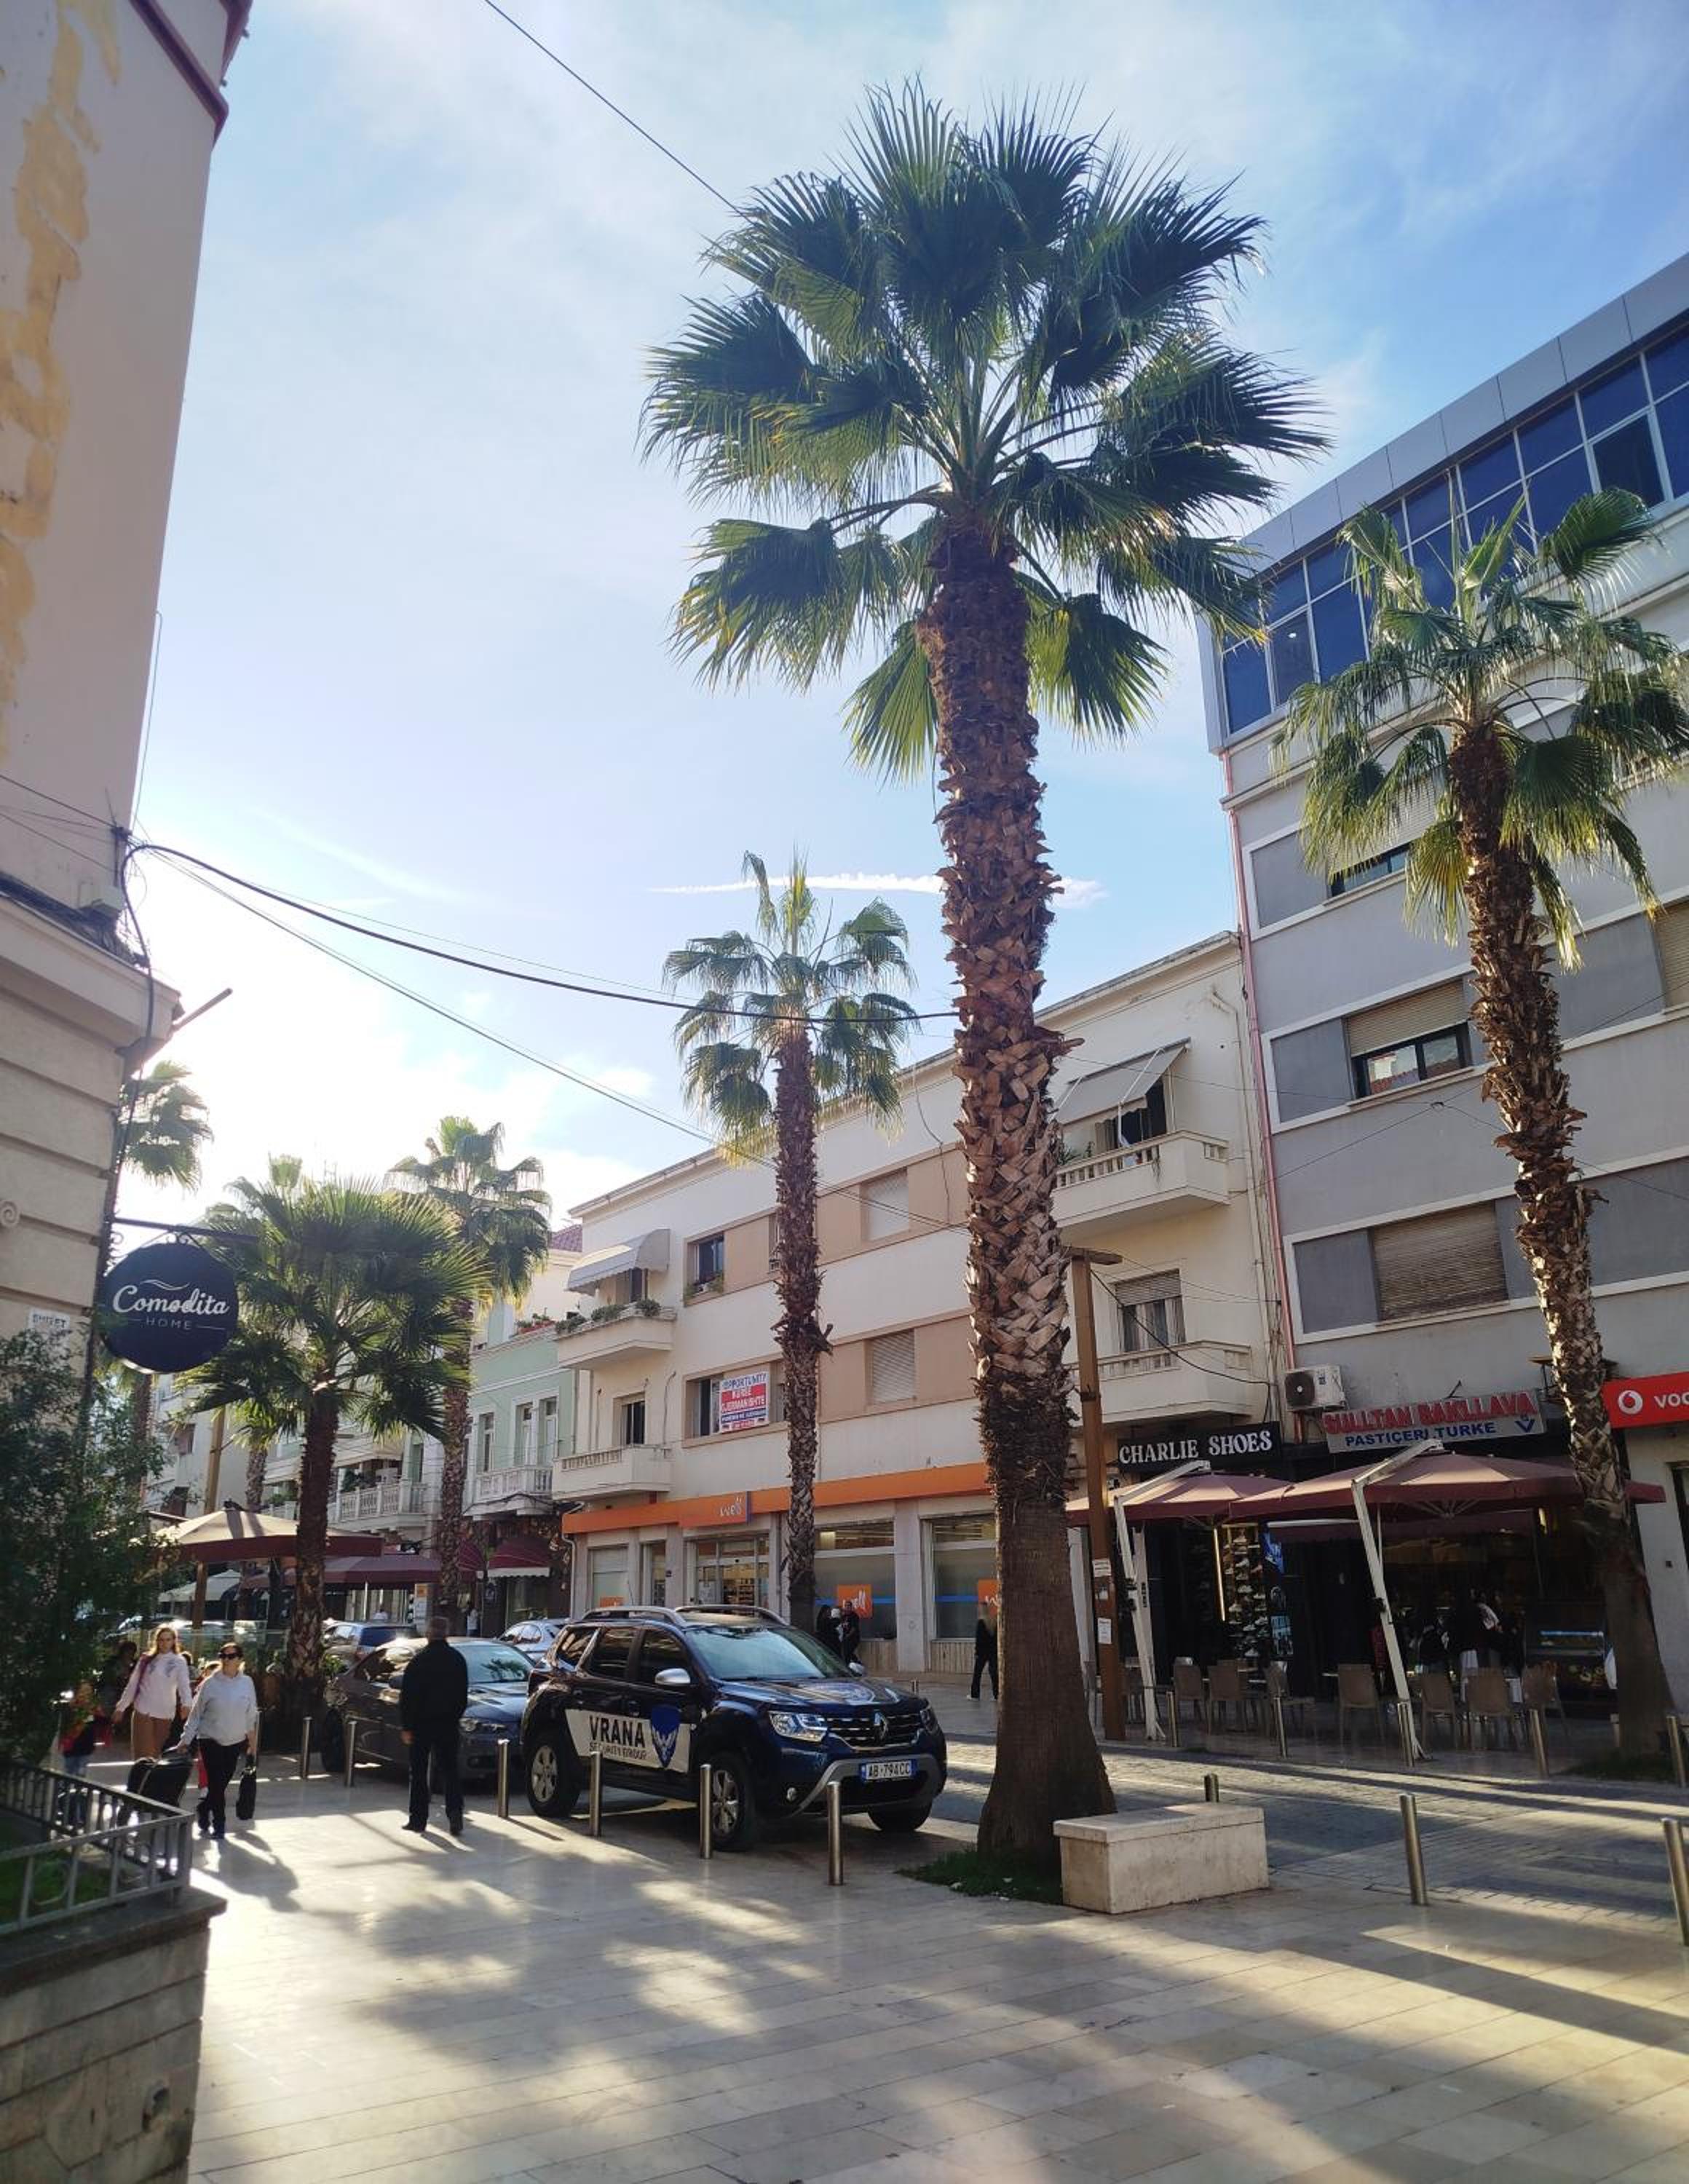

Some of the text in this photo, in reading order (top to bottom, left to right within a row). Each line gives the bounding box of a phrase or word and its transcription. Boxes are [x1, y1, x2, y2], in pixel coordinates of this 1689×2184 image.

[113, 1285, 231, 1315] Comodita
[146, 1315, 193, 1331] HOME
[1119, 1430, 1273, 1464] CHARLIE SHOES
[589, 1715, 646, 1748] VRANA
